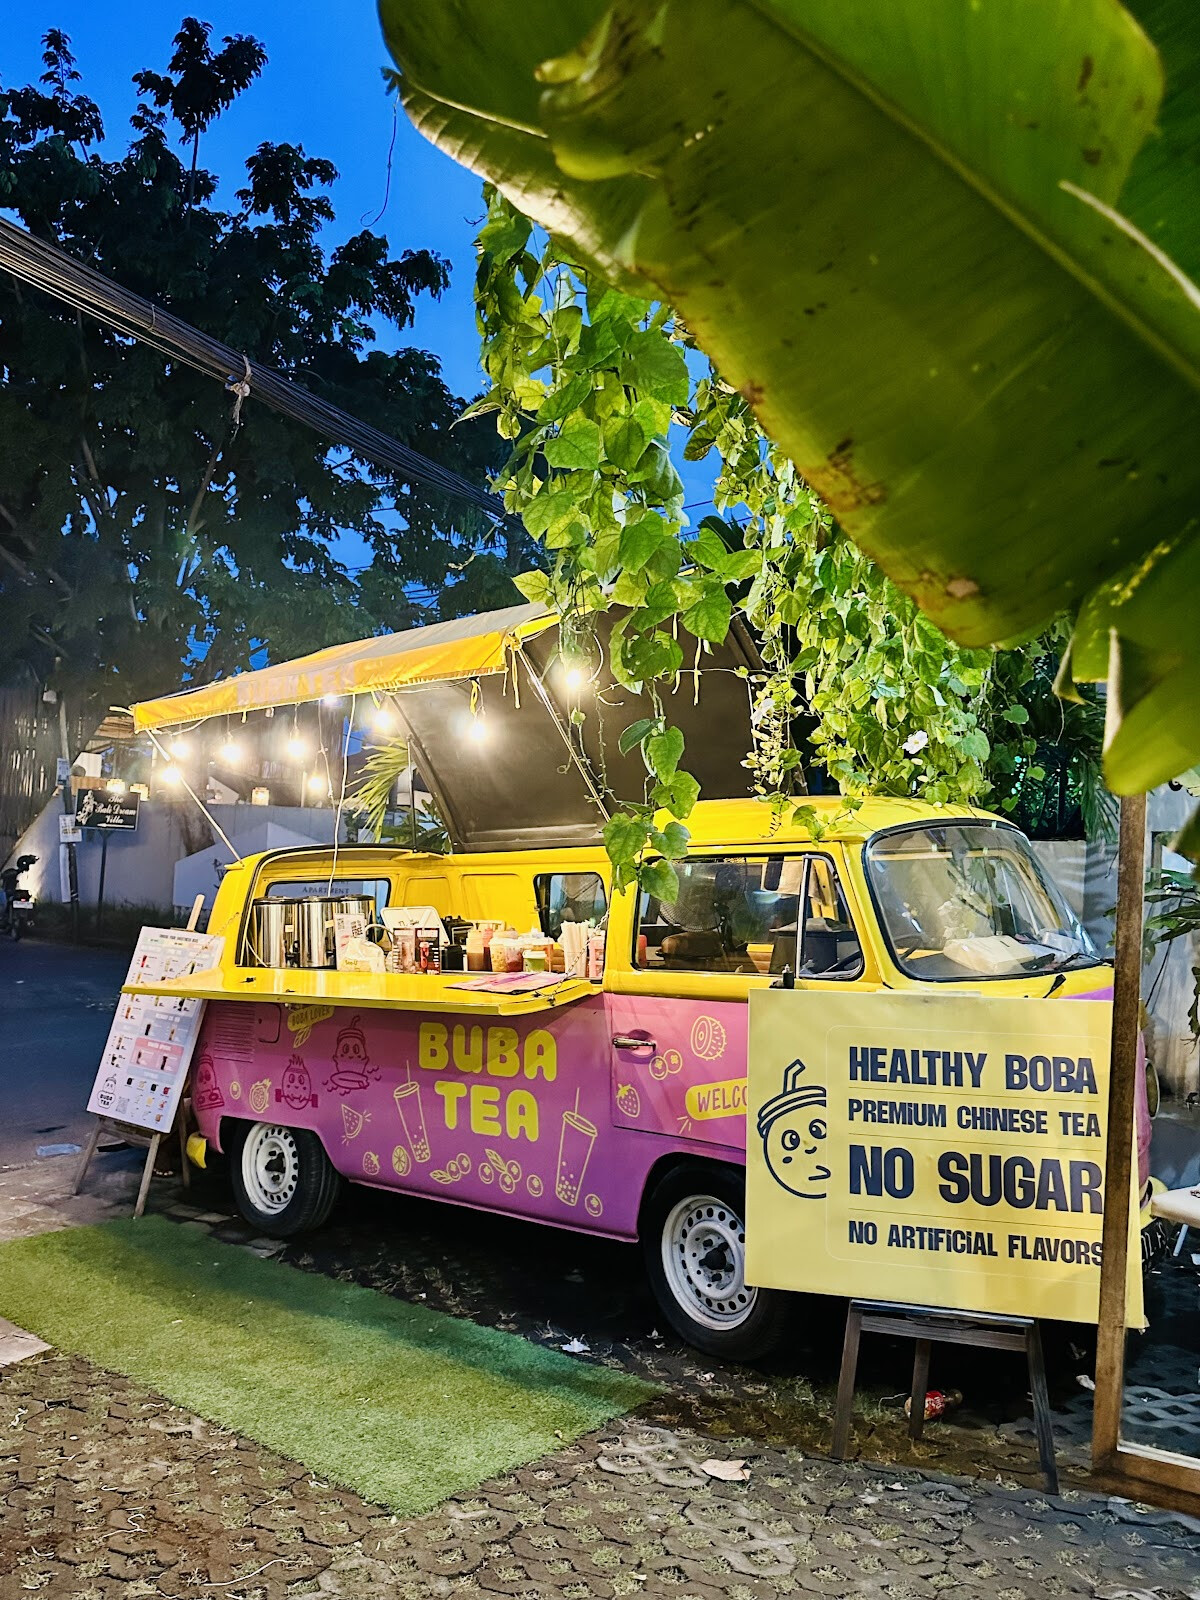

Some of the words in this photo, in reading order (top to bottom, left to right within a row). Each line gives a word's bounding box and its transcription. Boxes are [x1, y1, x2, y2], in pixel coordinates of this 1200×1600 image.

[95, 803, 112, 813] Bali
[112, 803, 137, 816] Dream
[105, 815, 124, 824] Villa
[108, 795, 123, 803] The
[419, 1022, 557, 1082] BUBA
[849, 1046, 988, 1089] HEALTHY
[1004, 1054, 1099, 1095] BOBA
[434, 1080, 539, 1142] TEA
[1058, 1111, 1102, 1138] TEA
[849, 1144, 915, 1200] NO
[937, 1151, 1104, 1215] SUGAR
[848, 1220, 878, 1246] NO
[1007, 1234, 1104, 1267] FLAVORS
